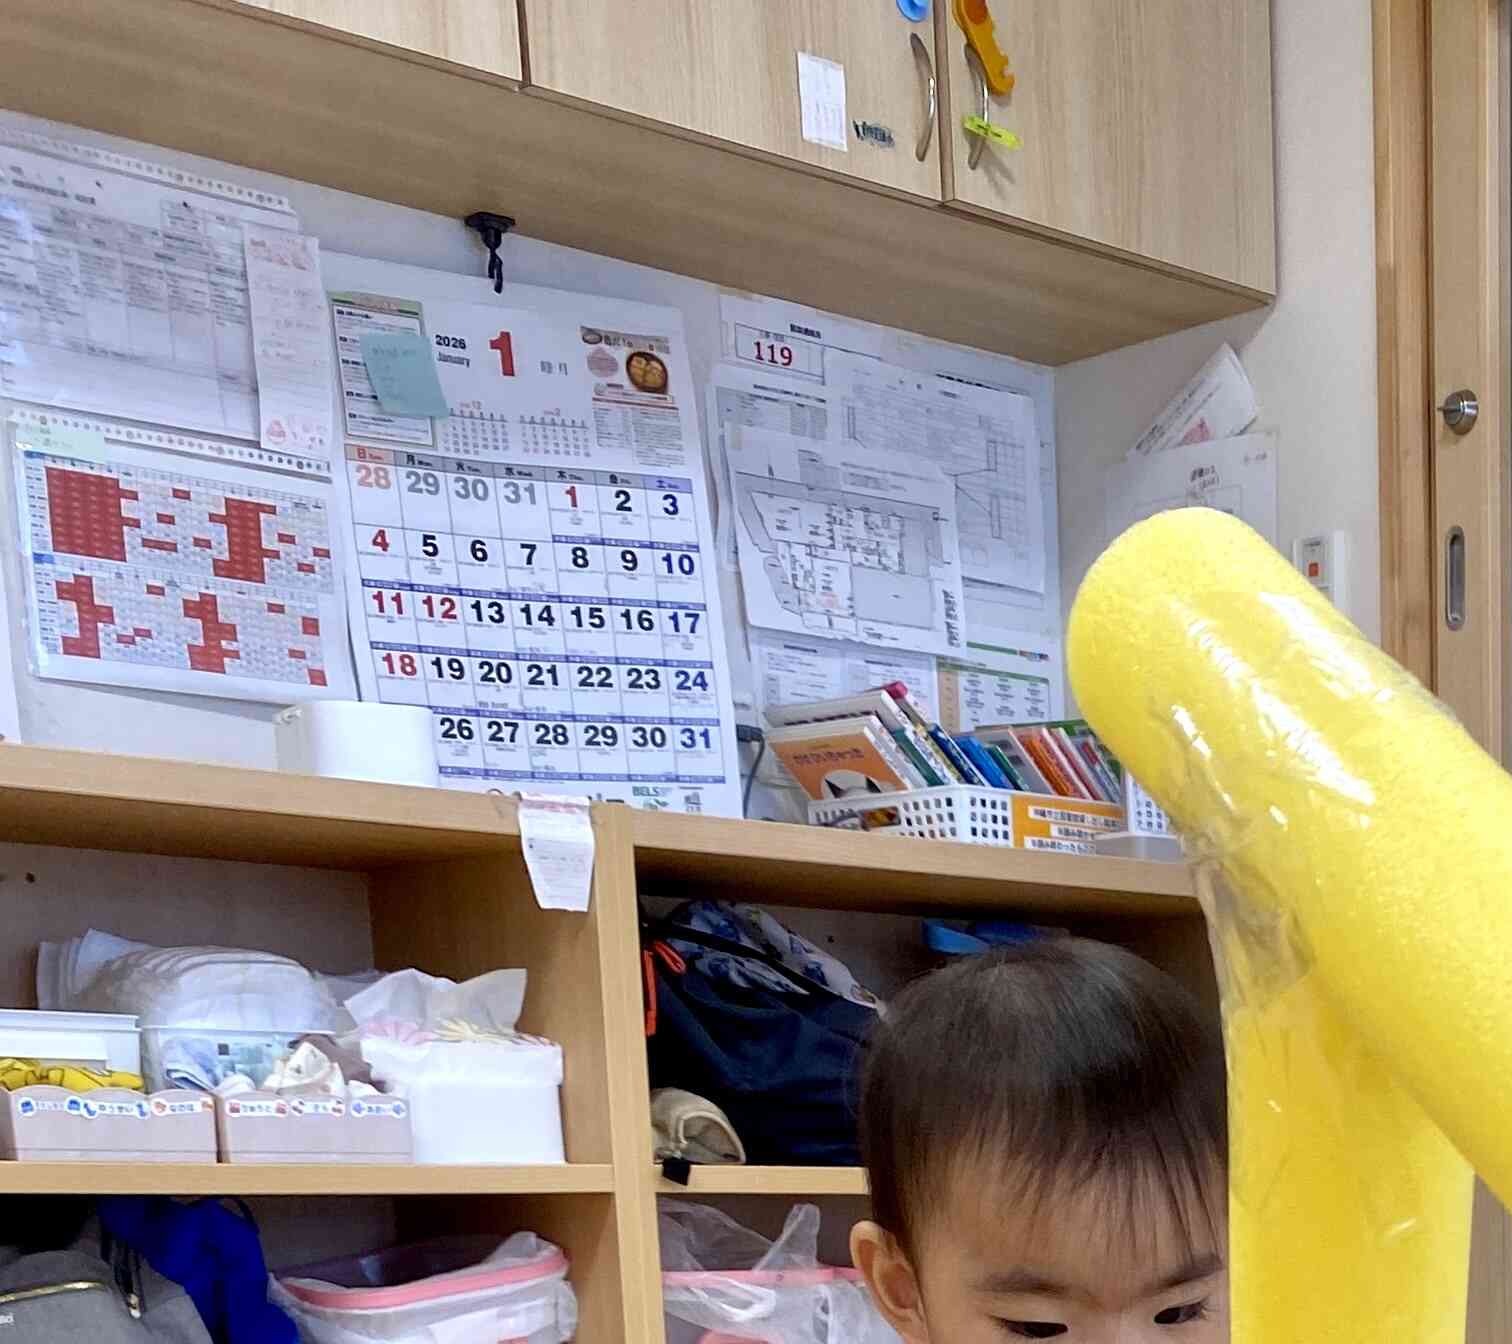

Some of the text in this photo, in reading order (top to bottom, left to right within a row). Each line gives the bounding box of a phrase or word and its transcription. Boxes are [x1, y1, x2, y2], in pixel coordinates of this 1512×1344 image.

[435, 331, 515, 377] 2026 1
[436, 351, 471, 368] January
[753, 340, 793, 366] 119
[355, 464, 680, 516] 28 29 30 31 1 2 3
[372, 529, 695, 575] 4 5 6 7 8 9 10
[373, 591, 700, 634] 11 12 13 14 15 16 17
[382, 652, 708, 692] 18 19 20 21 22 23 24
[439, 717, 711, 749] 26 27 28 29 30 31
